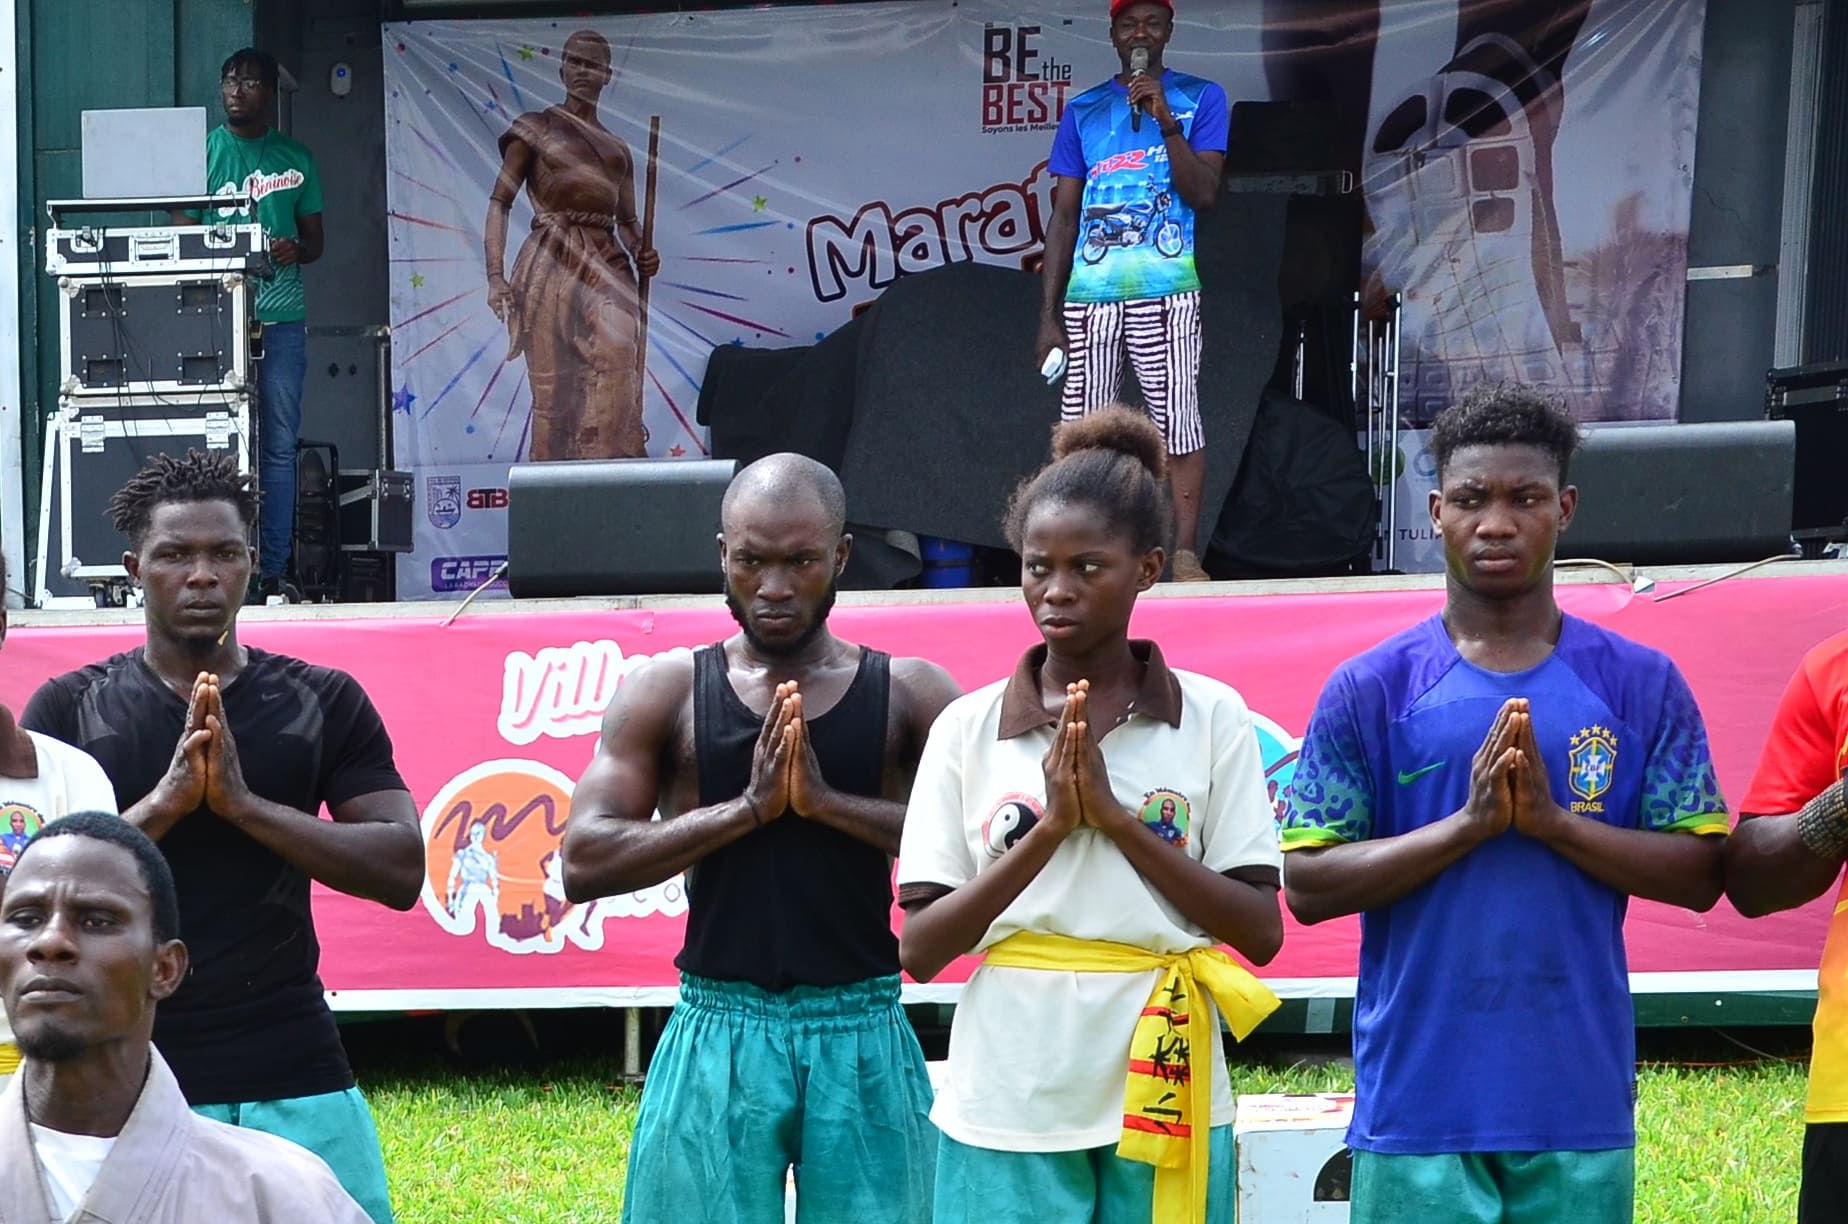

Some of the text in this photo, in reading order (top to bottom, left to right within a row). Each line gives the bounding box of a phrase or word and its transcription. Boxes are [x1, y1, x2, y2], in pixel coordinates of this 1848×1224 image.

[983, 26, 1071, 83] BE the
[982, 80, 1071, 125] BEST
[982, 126, 1013, 135] Soyons
[1015, 124, 1028, 132] les
[806, 160, 1058, 301] Marat
[510, 650, 624, 731] Vill
[1570, 801, 1605, 813] BRASIL
